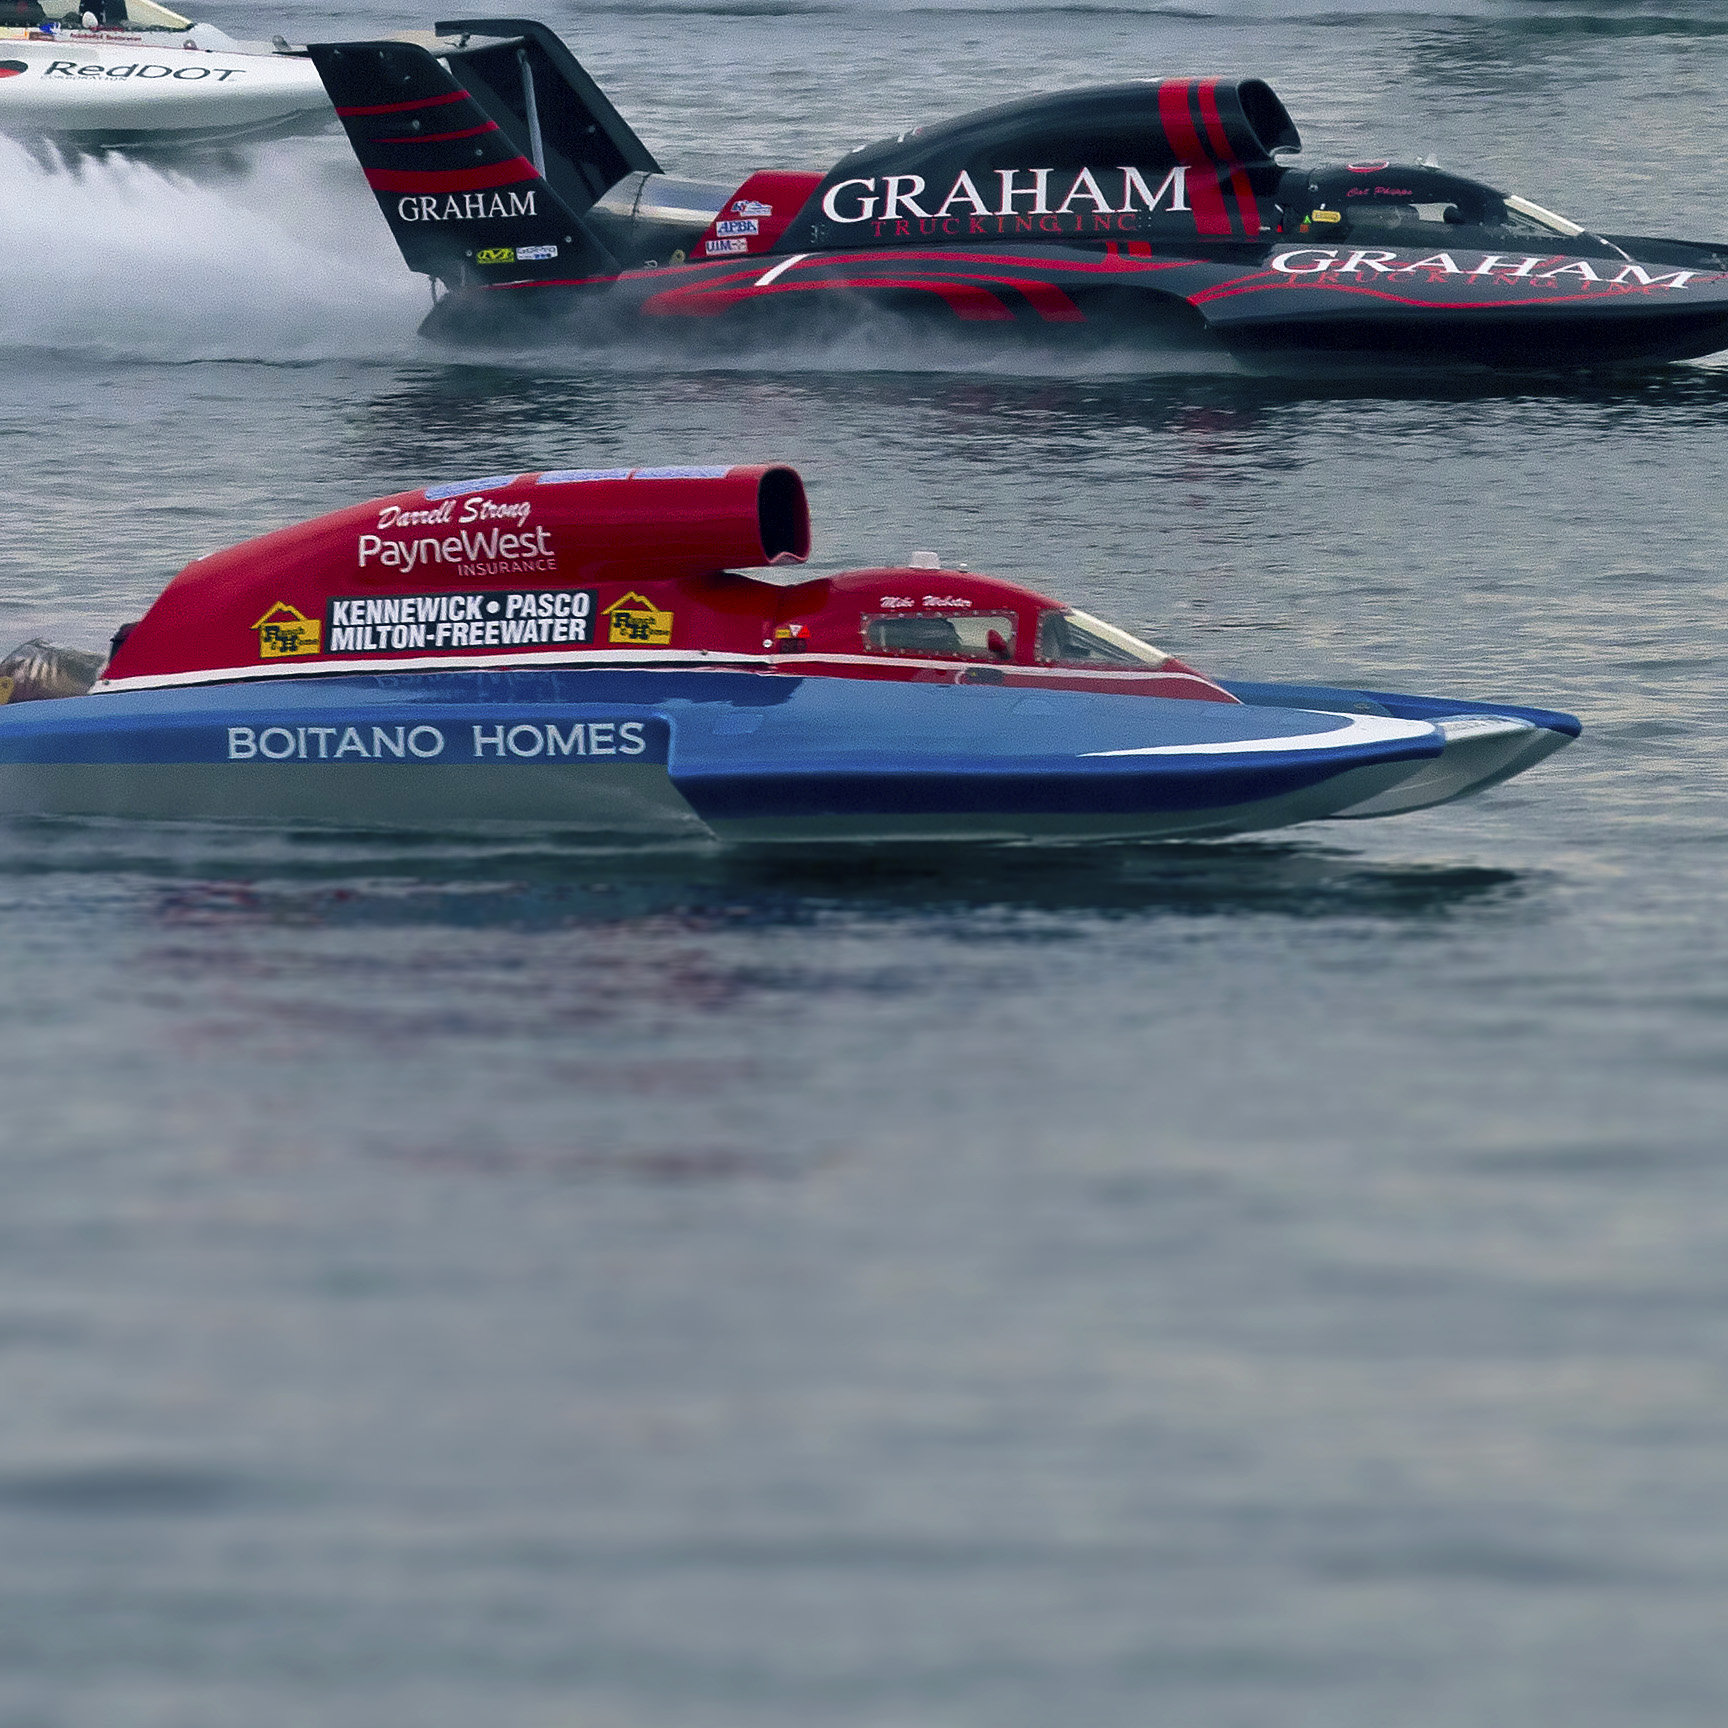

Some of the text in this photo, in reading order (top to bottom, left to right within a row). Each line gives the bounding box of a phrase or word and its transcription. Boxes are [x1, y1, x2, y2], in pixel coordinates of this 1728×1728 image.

[44, 60, 247, 82] RedDOT
[398, 190, 538, 222] GRAHAM
[821, 166, 1192, 224] GRAHAM
[718, 220, 757, 234] APBA
[1272, 249, 1702, 289] GRAHAM
[377, 497, 532, 530] Darrell Strong
[359, 525, 555, 573] PayneWest
[457, 558, 557, 576] INSURANCE
[332, 592, 591, 626] KENNEWICK PASCO
[330, 618, 587, 651] MILTON-FREEWATER
[227, 722, 647, 759] BOITANO HOMES
